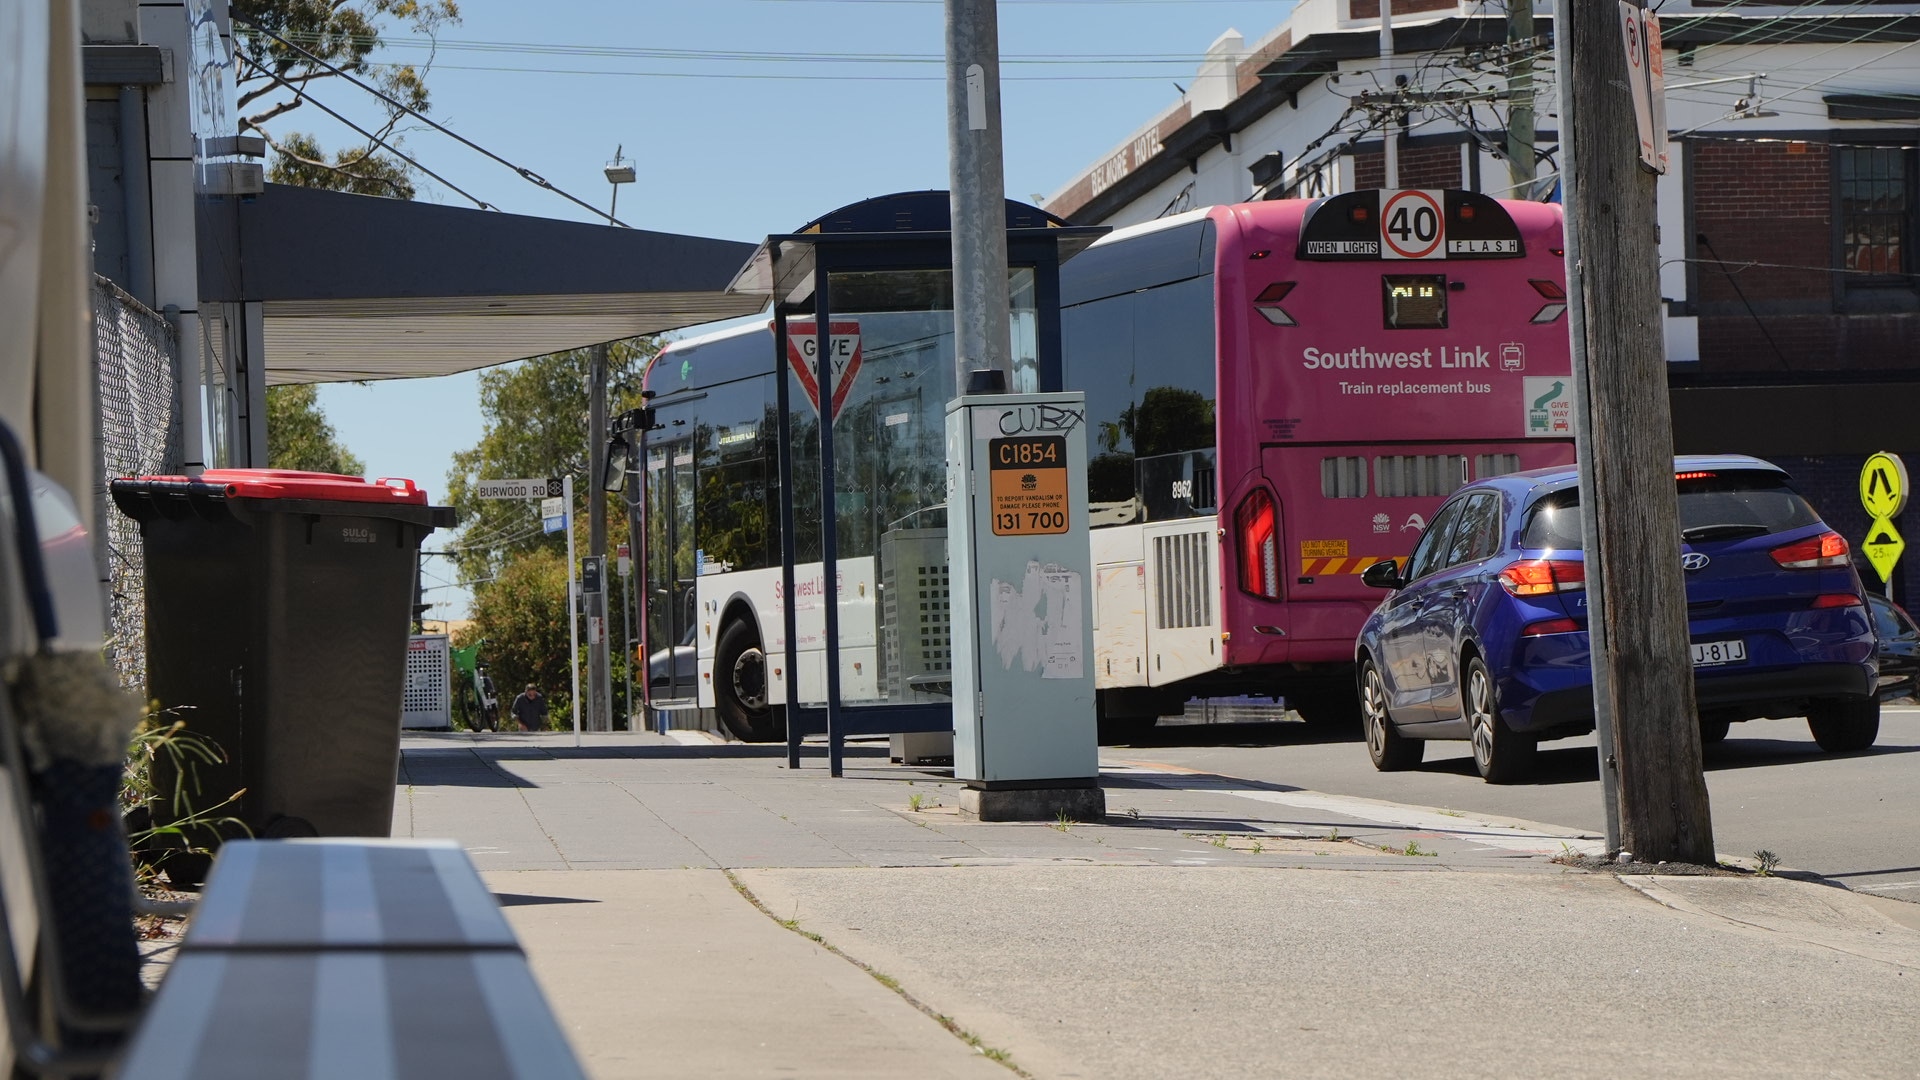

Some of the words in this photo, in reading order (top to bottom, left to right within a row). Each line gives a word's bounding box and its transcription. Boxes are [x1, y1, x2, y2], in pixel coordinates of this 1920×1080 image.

[1091, 147, 1128, 198] BELMORE
[1134, 125, 1166, 168] HOTEL
[1388, 206, 1437, 242] 40
[1308, 242, 1337, 254] WHEN
[1343, 241, 1377, 253] LIGHTS
[1456, 240, 1517, 252] FLASH
[804, 339, 850, 356] GVE
[1303, 347, 1432, 370] Southwest
[1440, 346, 1490, 368] Link
[1339, 381, 1374, 394] Train
[1377, 381, 1463, 396] replacement
[1466, 381, 1491, 394] bus
[1552, 410, 1569, 418] WAY
[1000, 443, 1056, 464] C1854
[480, 486, 527, 497] BURWOOD
[533, 486, 545, 496] RD
[1172, 480, 1192, 499] 8962
[997, 513, 1020, 530] 131
[1028, 511, 1064, 529] 700
[342, 528, 368, 537] SULO
